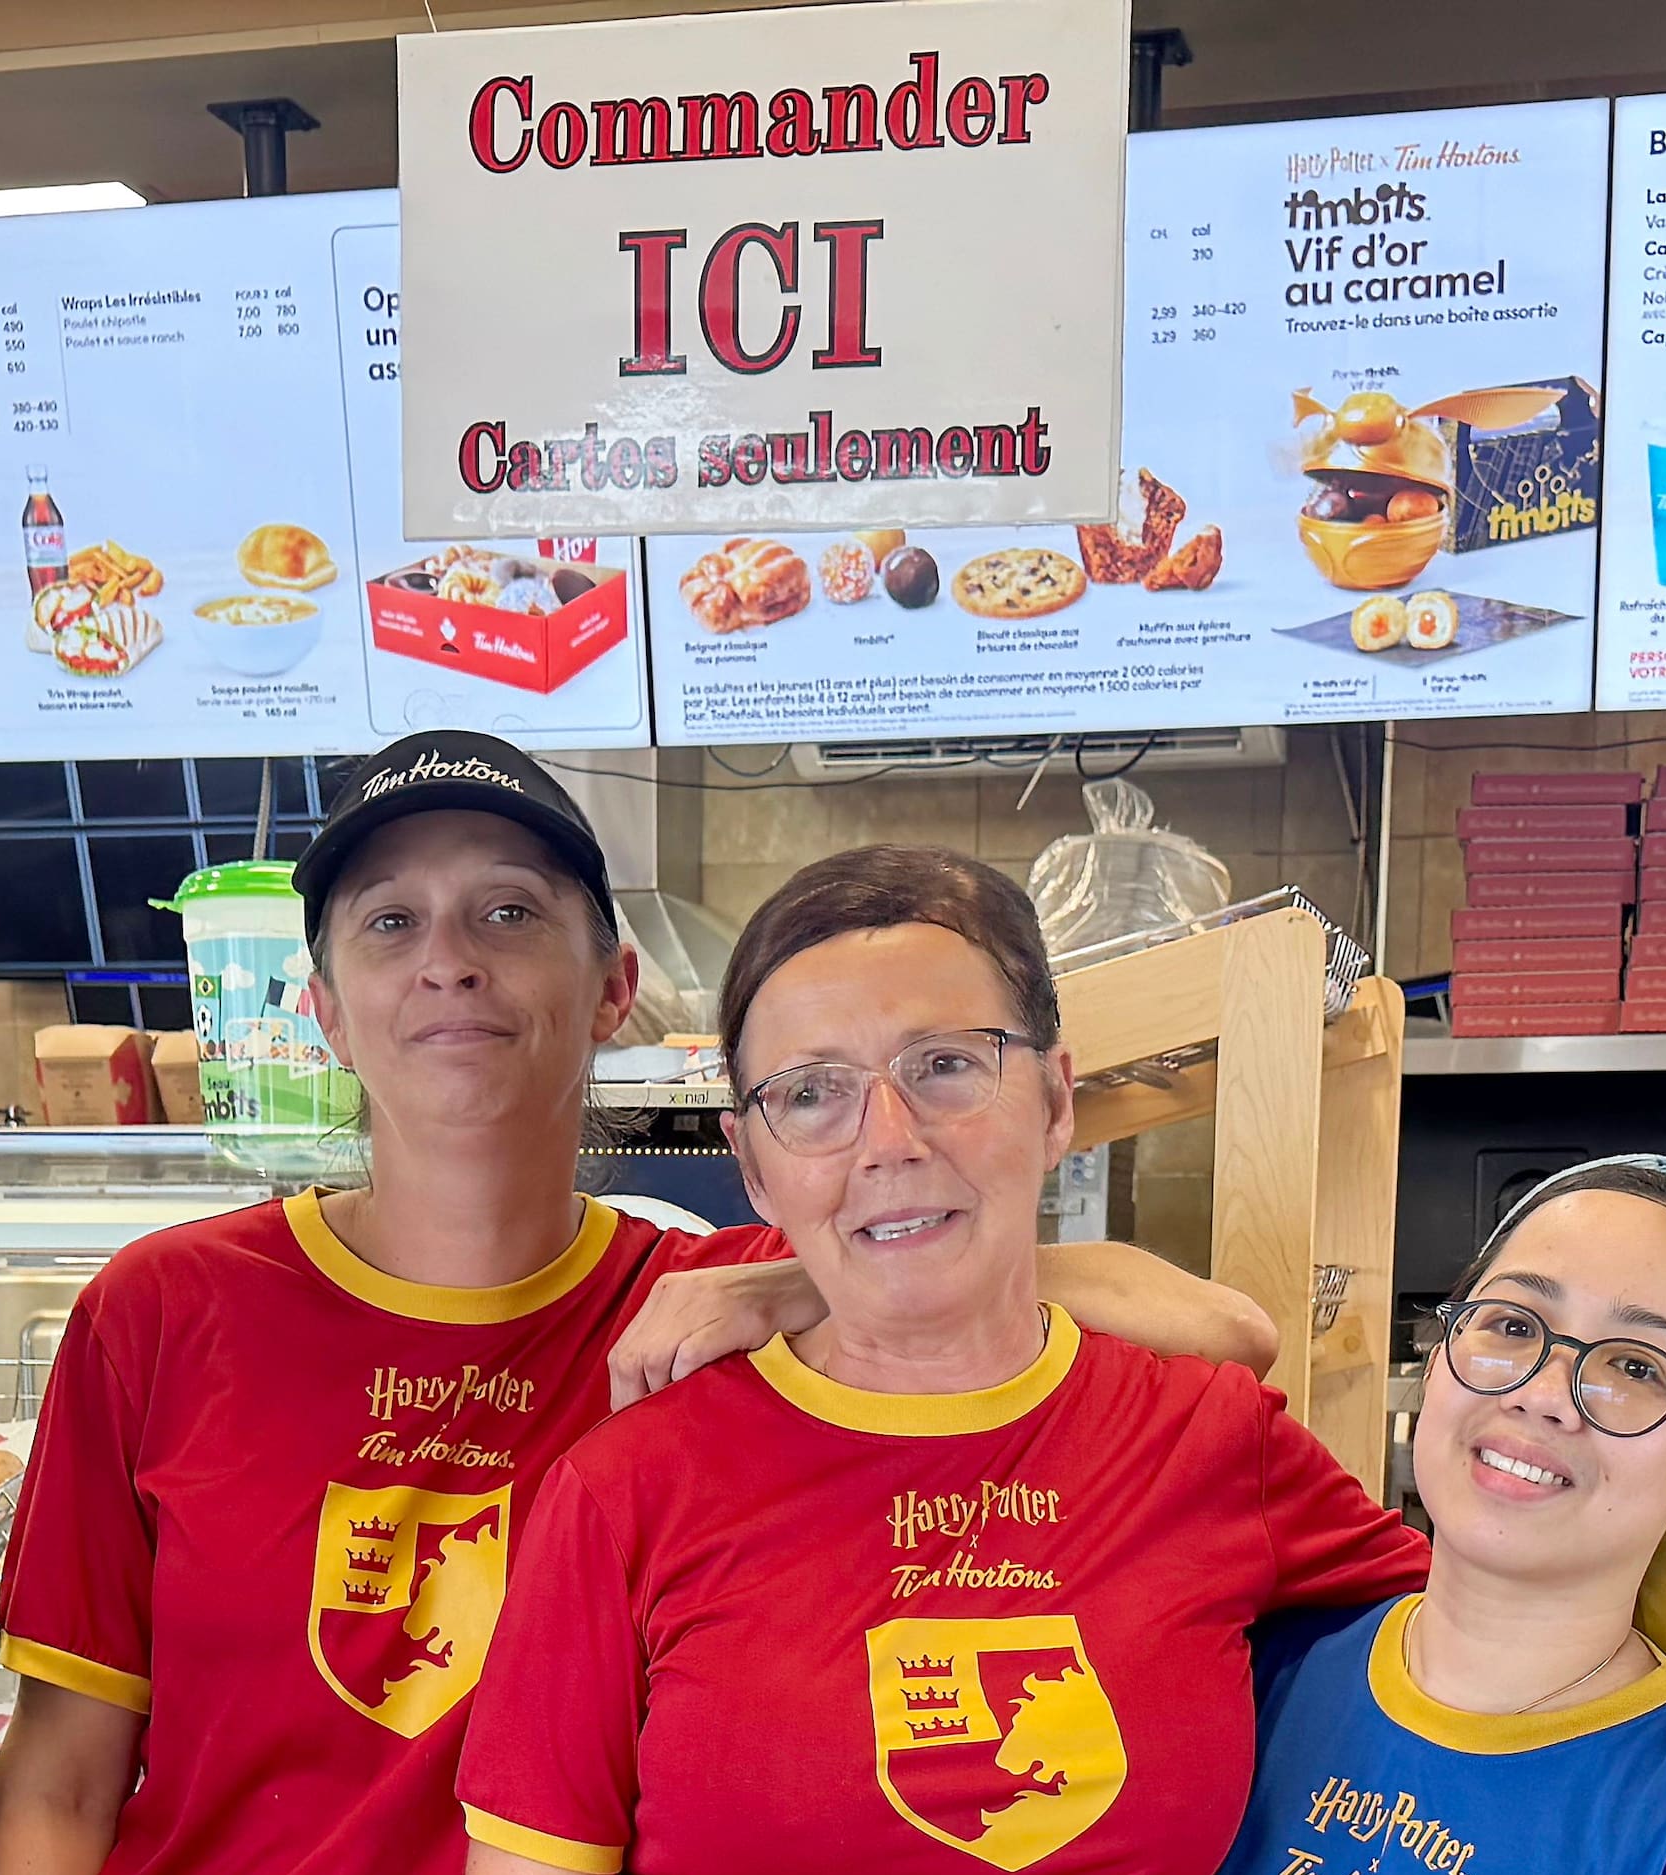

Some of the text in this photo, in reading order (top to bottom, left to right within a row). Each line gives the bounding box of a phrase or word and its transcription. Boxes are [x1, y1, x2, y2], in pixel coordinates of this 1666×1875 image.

[468, 50, 1050, 174] Commander
[1394, 144, 1432, 172] Tim
[1284, 236, 1341, 273] Vif
[619, 219, 884, 377] ICI
[1285, 259, 1505, 307] au caramel
[62, 295, 103, 311] Wraps
[1285, 302, 1558, 334] Trouvez-le dans une boîte assortie
[366, 328, 397, 346] un
[369, 362, 400, 381] as
[458, 406, 1051, 495] Cartes seulement
[362, 768, 406, 802] Tim
[365, 1365, 534, 1420] Harry Potter
[358, 1431, 405, 1467] Tim
[886, 1479, 1060, 1549] Harry Potter
[1305, 1777, 1389, 1842] Harry
